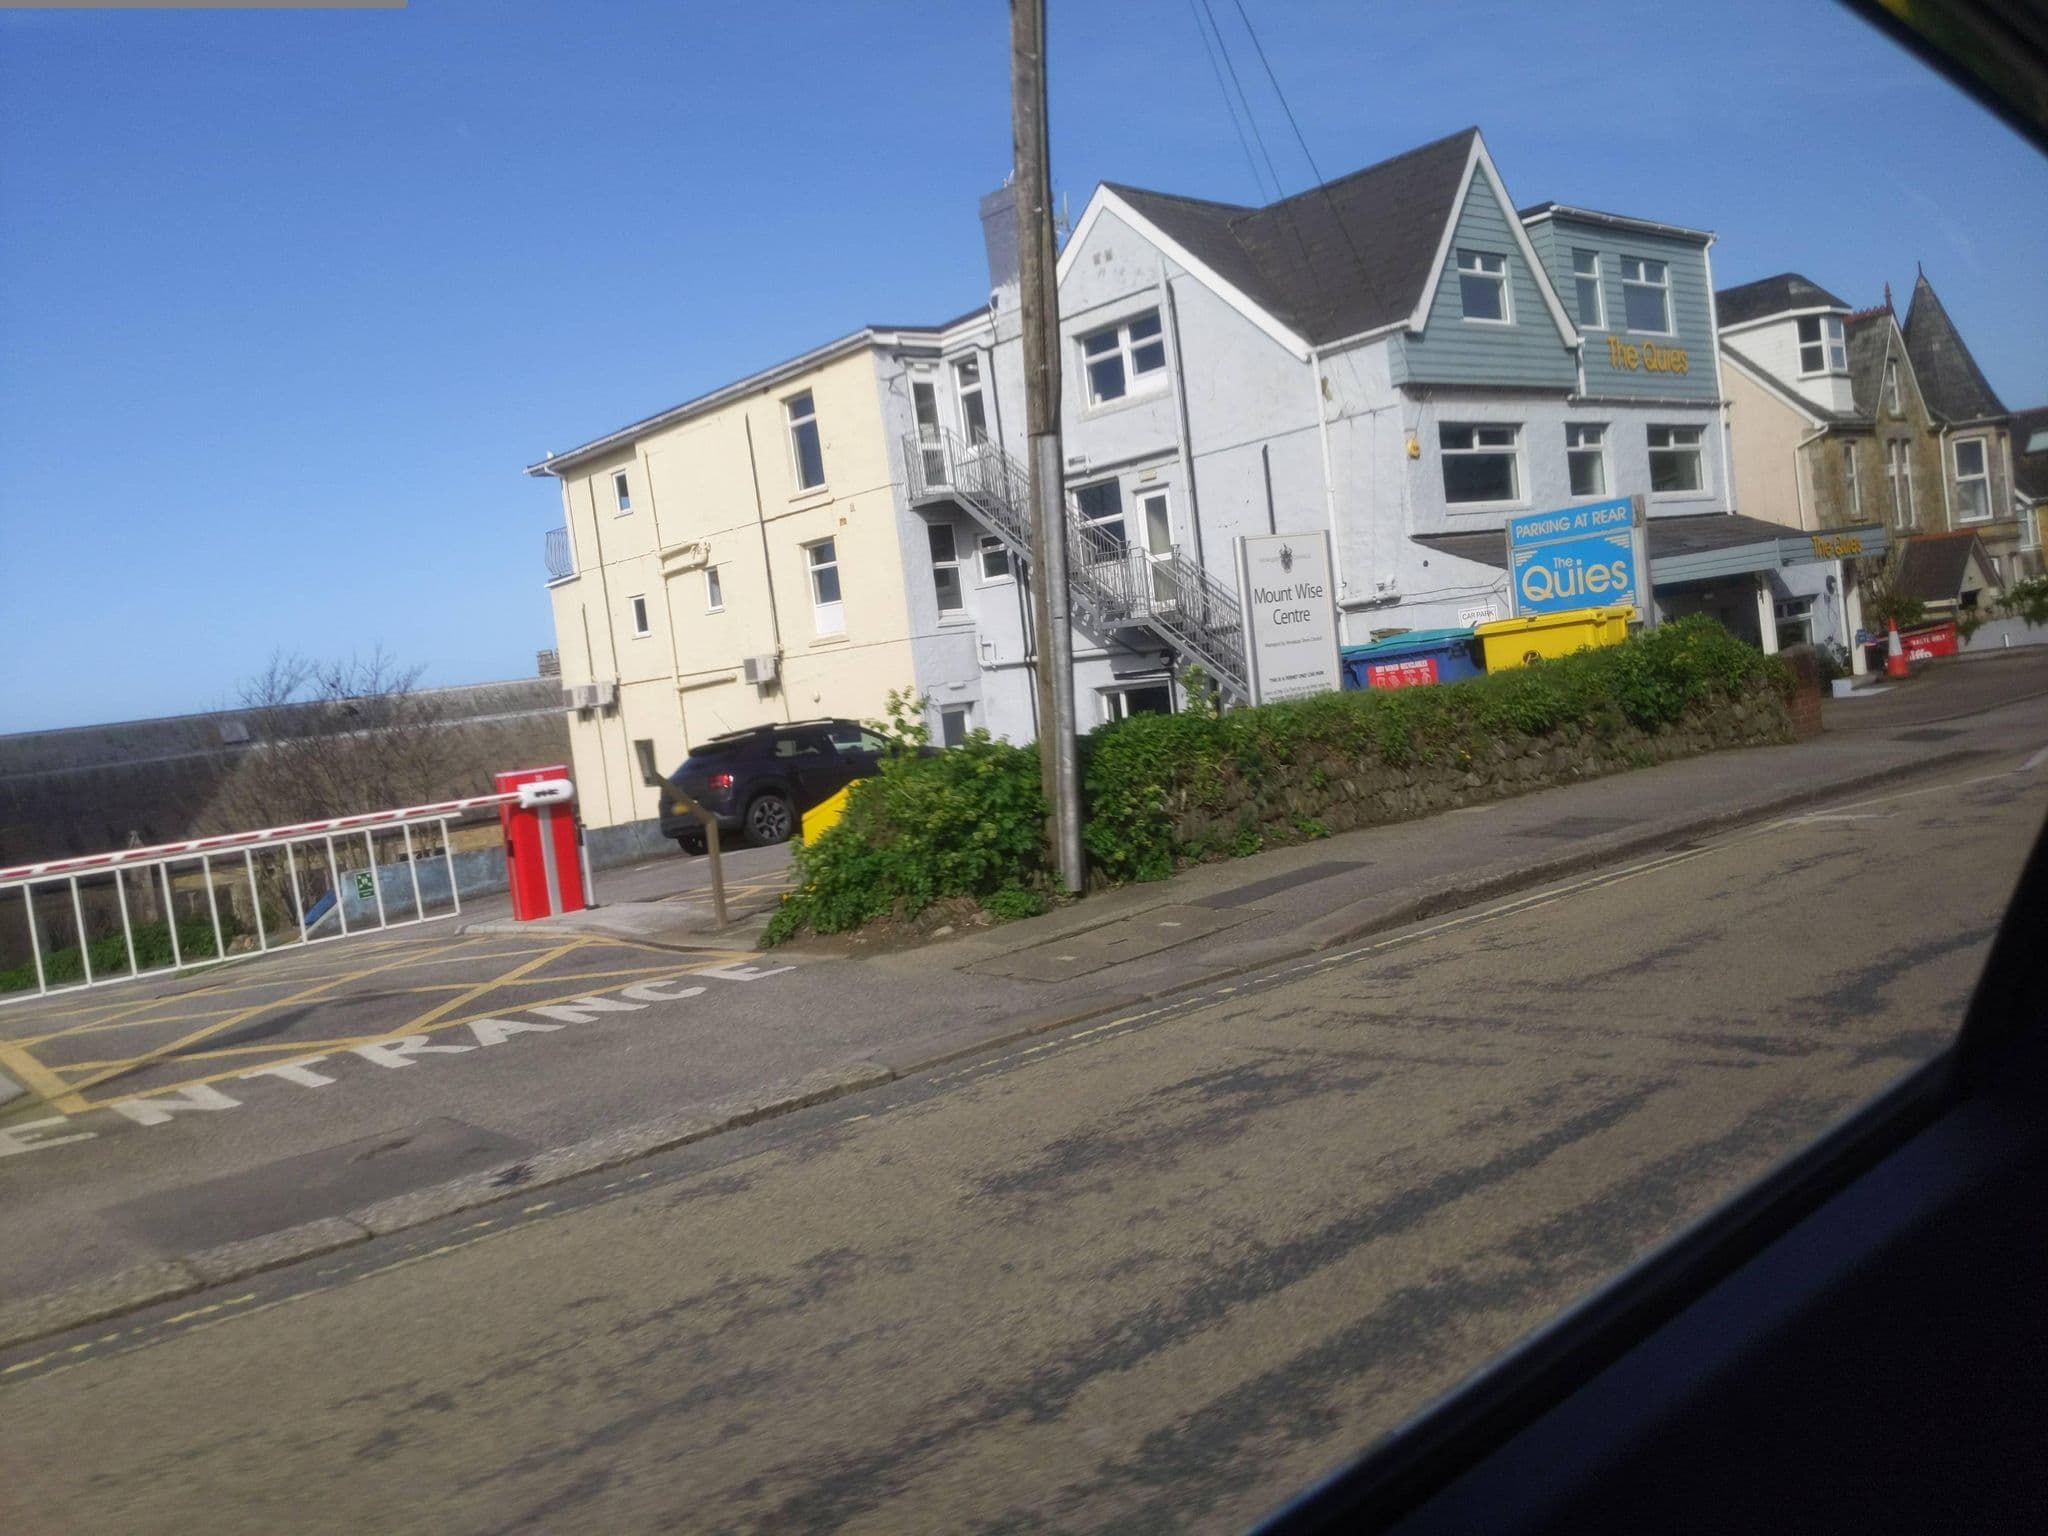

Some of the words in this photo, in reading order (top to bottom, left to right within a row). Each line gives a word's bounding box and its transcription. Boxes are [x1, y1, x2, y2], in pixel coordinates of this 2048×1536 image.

[1607, 335, 1638, 369] The
[1643, 340, 1689, 376] Quies
[1516, 517, 1571, 539] PARKING
[1574, 512, 1589, 528] AT
[1592, 506, 1627, 526] REAR
[1553, 557, 1573, 569] The
[1254, 588, 1293, 605] Mount
[1295, 583, 1323, 600] Wise
[1522, 559, 1628, 602] Quies
[1273, 609, 1311, 626] Centre
